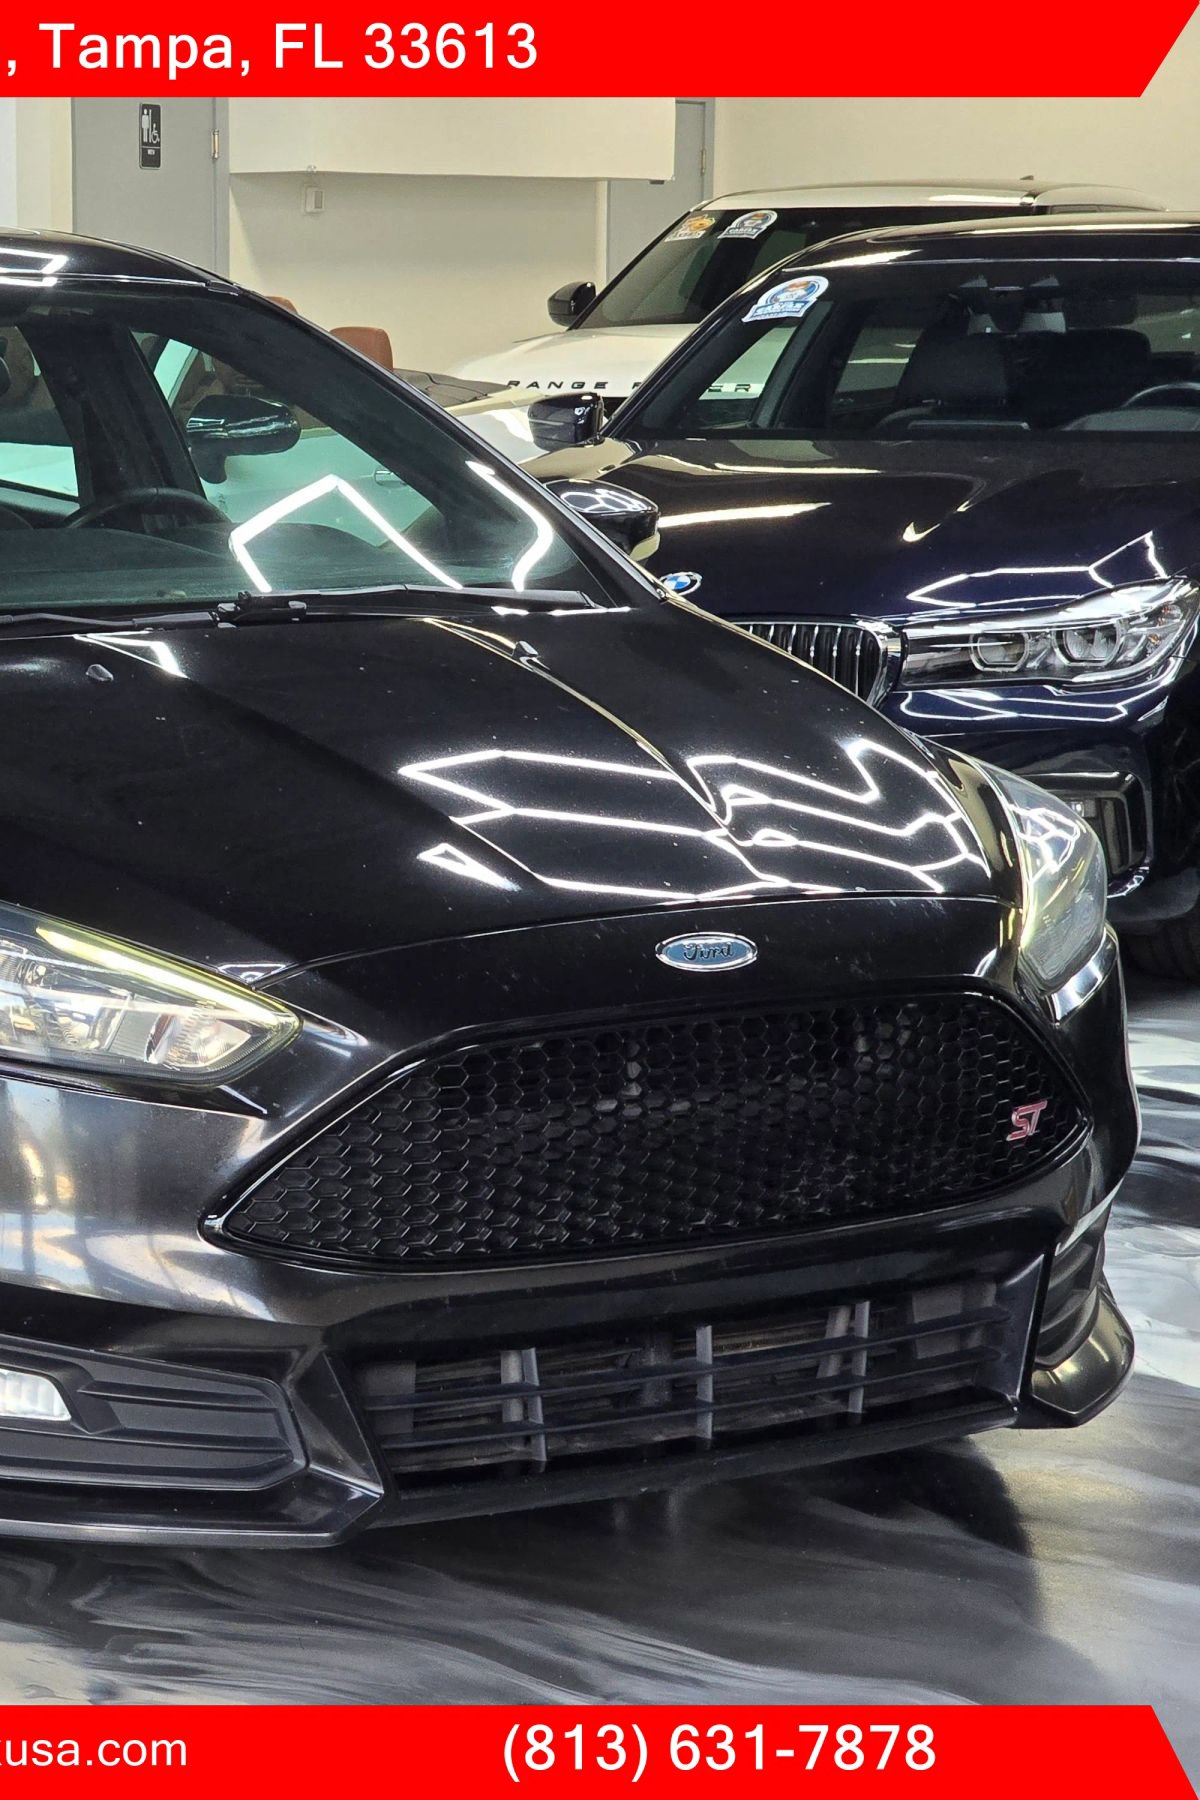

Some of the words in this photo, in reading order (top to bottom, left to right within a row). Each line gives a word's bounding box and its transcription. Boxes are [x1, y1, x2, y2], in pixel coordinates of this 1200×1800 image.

[506, 380, 609, 390] RANGE
[682, 941, 734, 961] Ford
[1006, 1100, 1048, 1141] ST
